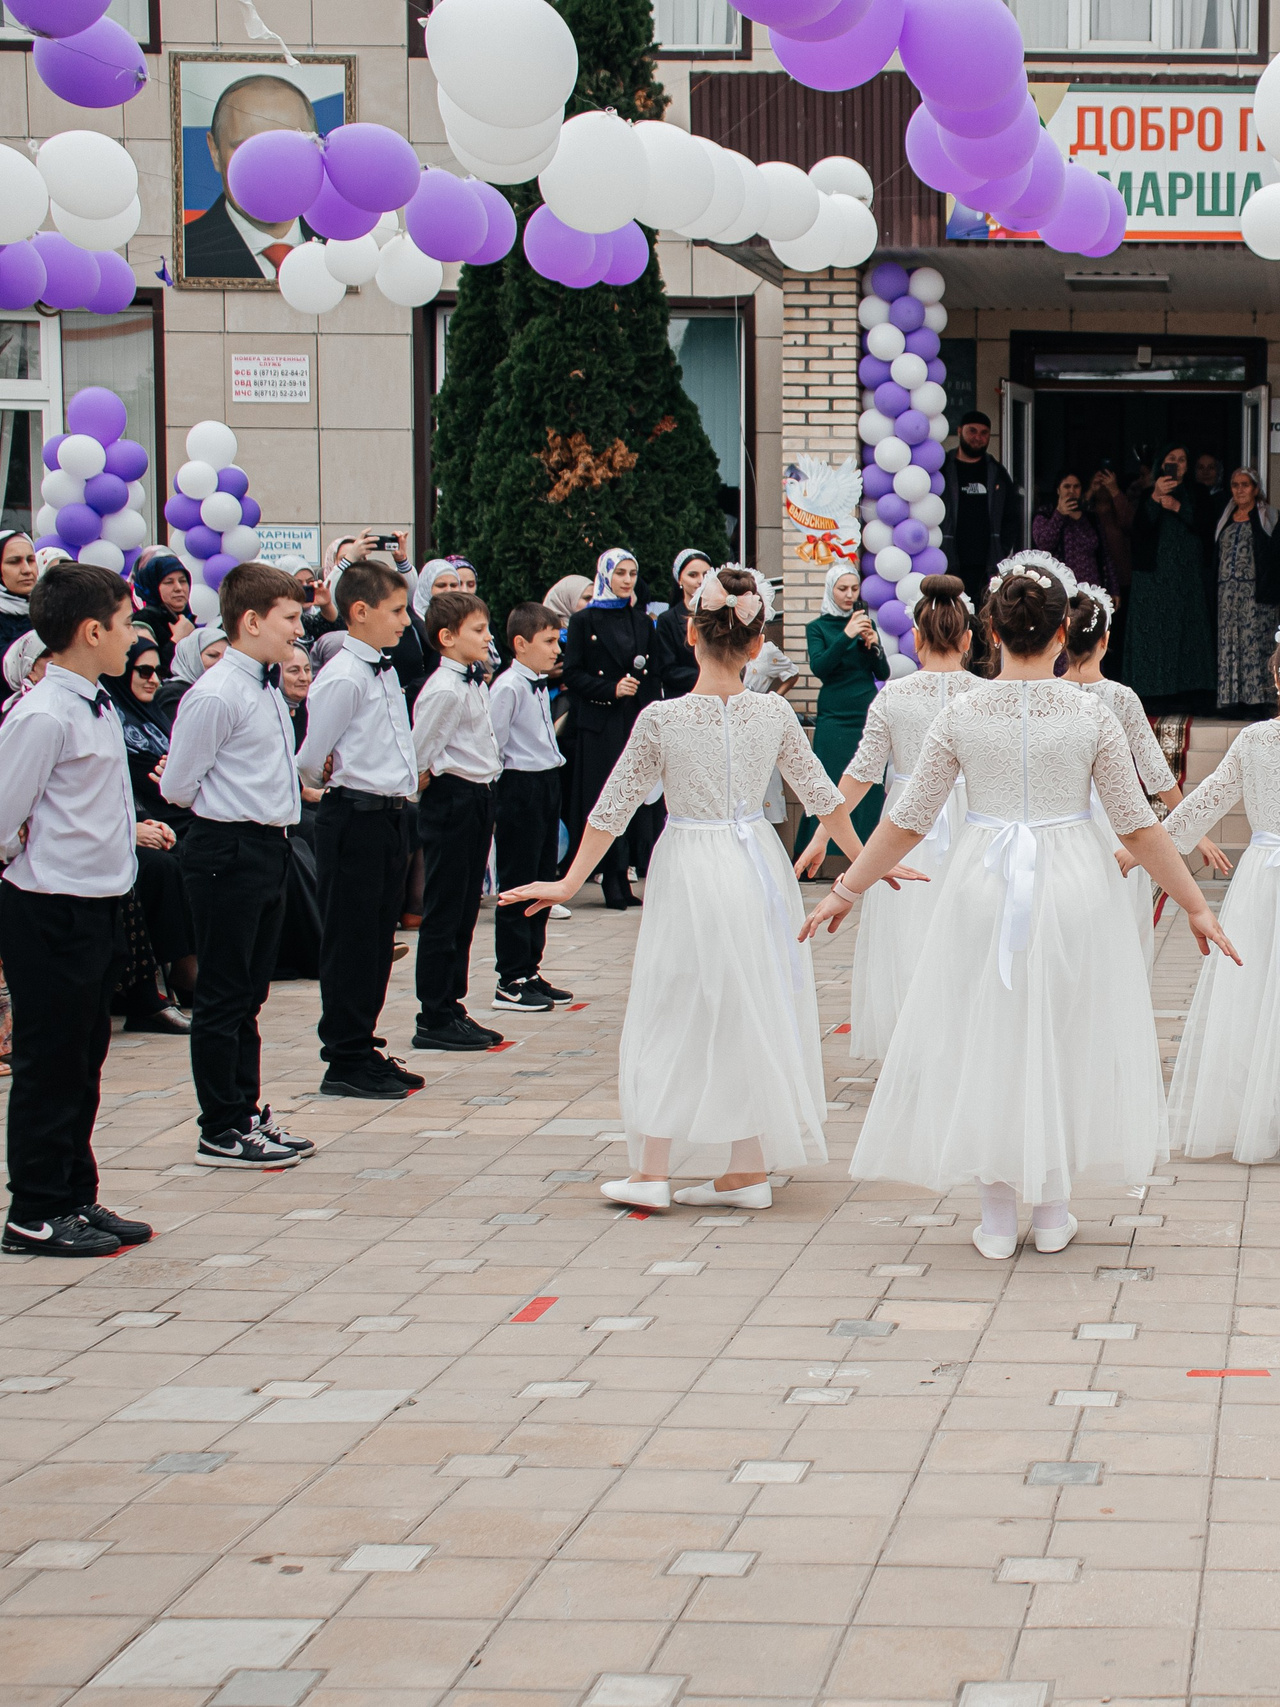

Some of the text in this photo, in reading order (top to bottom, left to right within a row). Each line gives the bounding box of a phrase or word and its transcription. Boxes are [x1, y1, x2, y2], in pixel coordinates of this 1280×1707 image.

[1069, 106, 1223, 155] ДОБРО
[259, 369, 279, 377] (8712)
[280, 369, 308, 377] 62-84-21
[234, 379, 252, 387] ОВД
[789, 504, 836, 529] ВЫПУСКНИК
[255, 529, 312, 539] ЖАРНЫЙ
